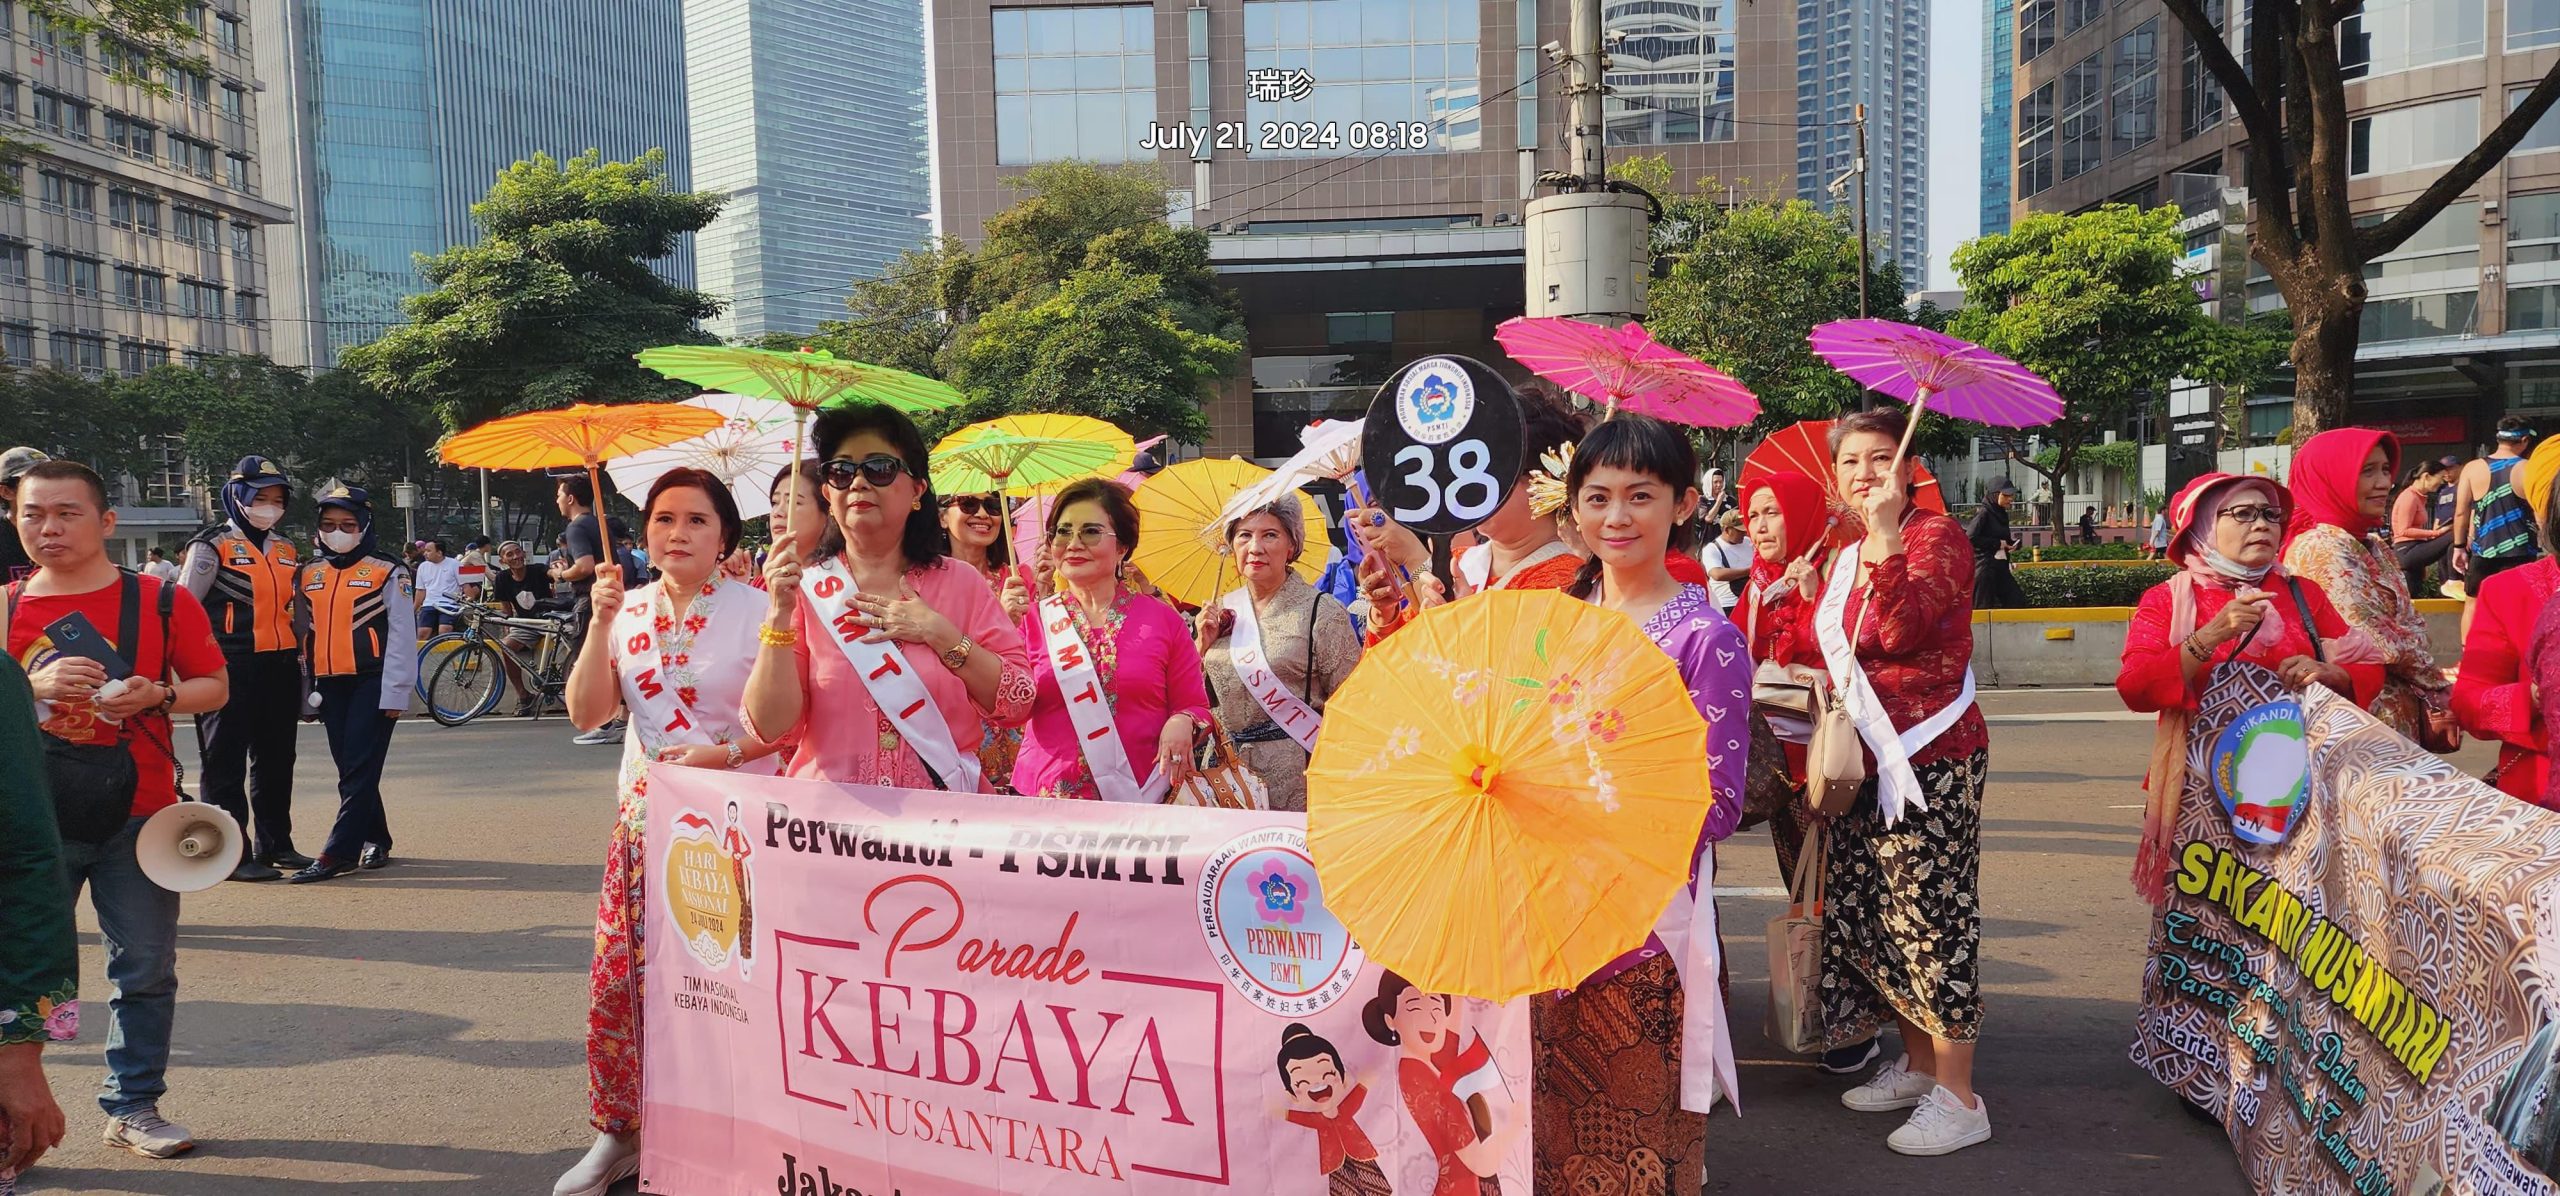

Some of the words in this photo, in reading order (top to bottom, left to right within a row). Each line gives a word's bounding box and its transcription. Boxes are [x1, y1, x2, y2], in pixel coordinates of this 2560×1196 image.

[1427, 422, 1448, 433] PSMTI
[1394, 438, 1499, 522] 38
[1237, 651, 1321, 742] PSMTI
[2235, 708, 2293, 741] SRIKANDI
[684, 850, 717, 871] HARI
[765, 801, 958, 867] Perwanti
[1000, 824, 1190, 886] PSMTI
[678, 864, 730, 895] KEBAYA
[681, 887, 729, 914] NASIONAL
[1203, 844, 1237, 938] PERSAUDARAAN
[1237, 832, 1284, 850] WANITA
[690, 912, 698, 925] 24
[708, 917, 724, 934] 2024
[863, 874, 1090, 985] Parade
[1245, 928, 1322, 960] PERWANTI
[683, 976, 702, 993] TIM
[704, 979, 739, 1004] NASIONAL
[1270, 962, 1302, 985] PSMTI
[674, 992, 709, 1012] KEBAYA
[710, 997, 750, 1024] INDONESIA
[2229, 945, 2288, 1019] Berperan
[2317, 1034, 2367, 1105] Dalam
[2300, 918, 2452, 1085] NUSANTARA
[795, 968, 1195, 1127] KEBAYA
[2154, 1017, 2222, 1072] akarta,
[2225, 996, 2277, 1064] Kebaya
[2318, 1101, 2359, 1174] Tahun
[851, 1087, 1126, 1181] NUSANTARA
[2453, 1105, 2476, 1137] Dewi
[2471, 1120, 2485, 1147] Sri
[2481, 1134, 2540, 1196] Rachmawati
[2468, 1162, 2499, 1196] KETUA
